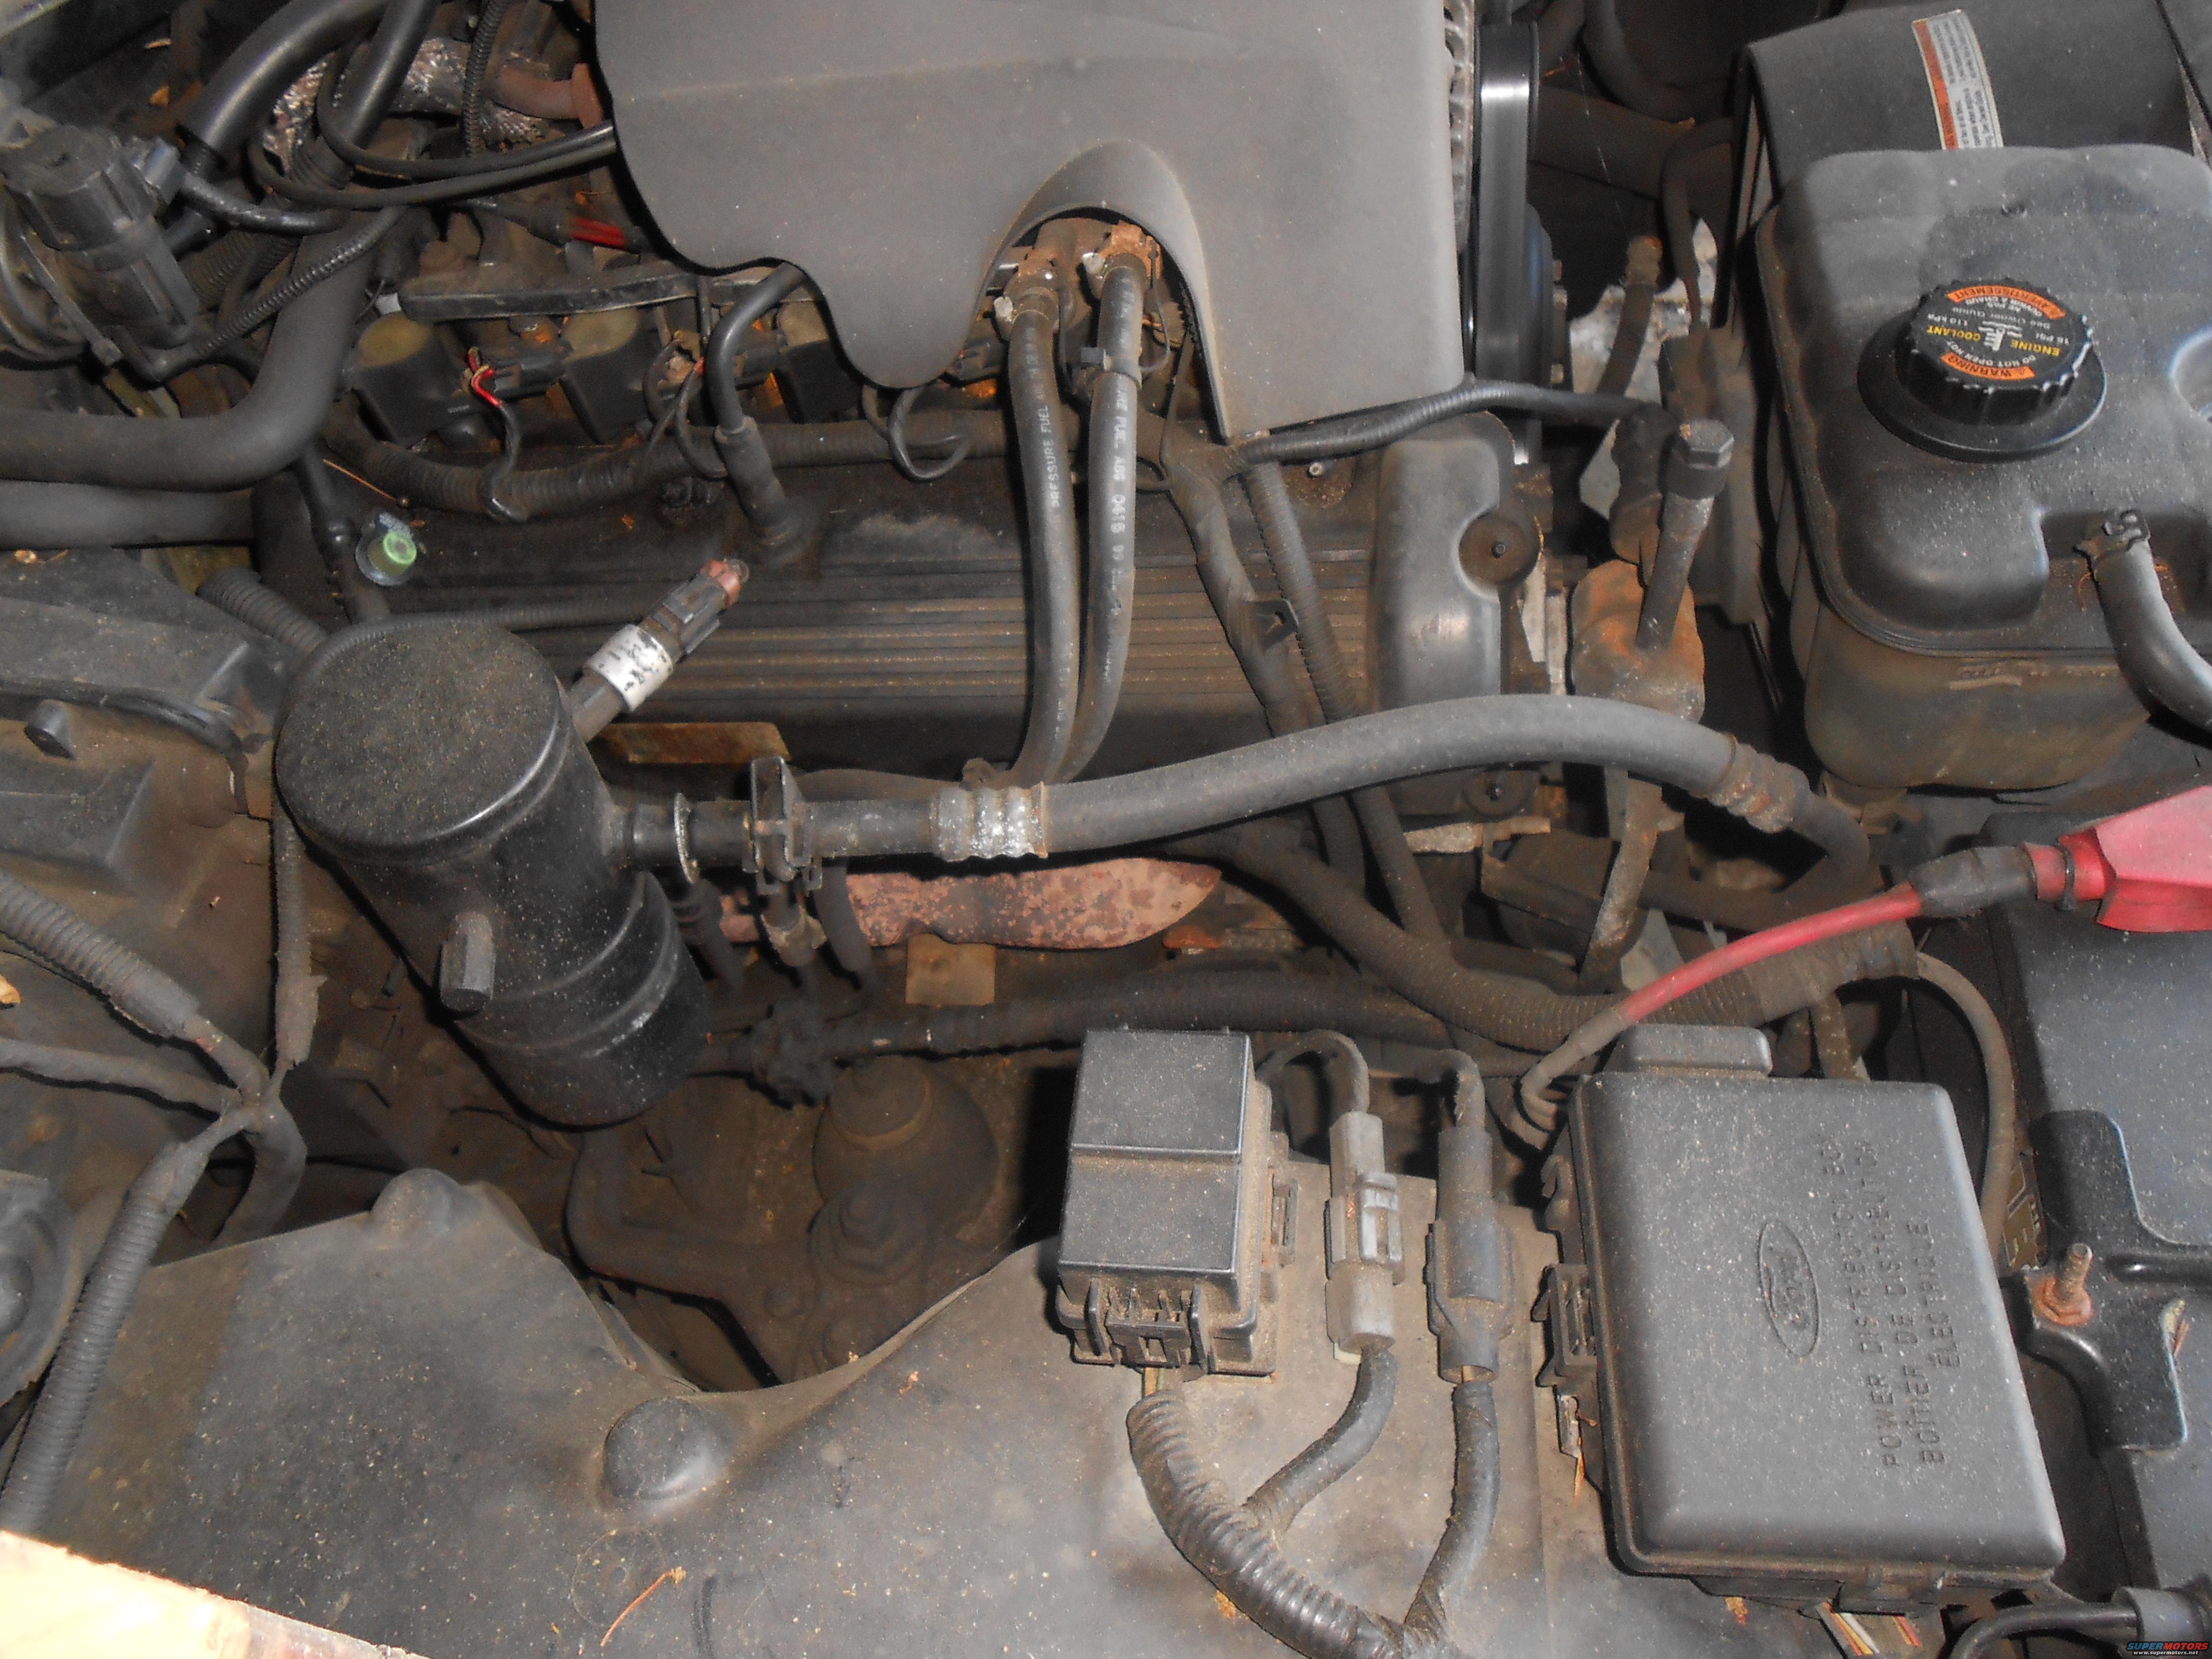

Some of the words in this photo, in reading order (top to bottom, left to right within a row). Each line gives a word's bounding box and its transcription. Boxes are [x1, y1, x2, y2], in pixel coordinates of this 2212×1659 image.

[1926, 325, 1982, 342] COOLANT
[2009, 339, 2062, 357] ENGINE
[2022, 355, 2036, 363] DO
[1948, 355, 2012, 377] WARNING
[1963, 353, 1994, 366] OPEN
[1037, 404, 1053, 433] FUEL
[1043, 438, 1061, 508] PRESSURE
[1888, 1314, 1918, 1345] DE
[1864, 1374, 1902, 1467] POWER
